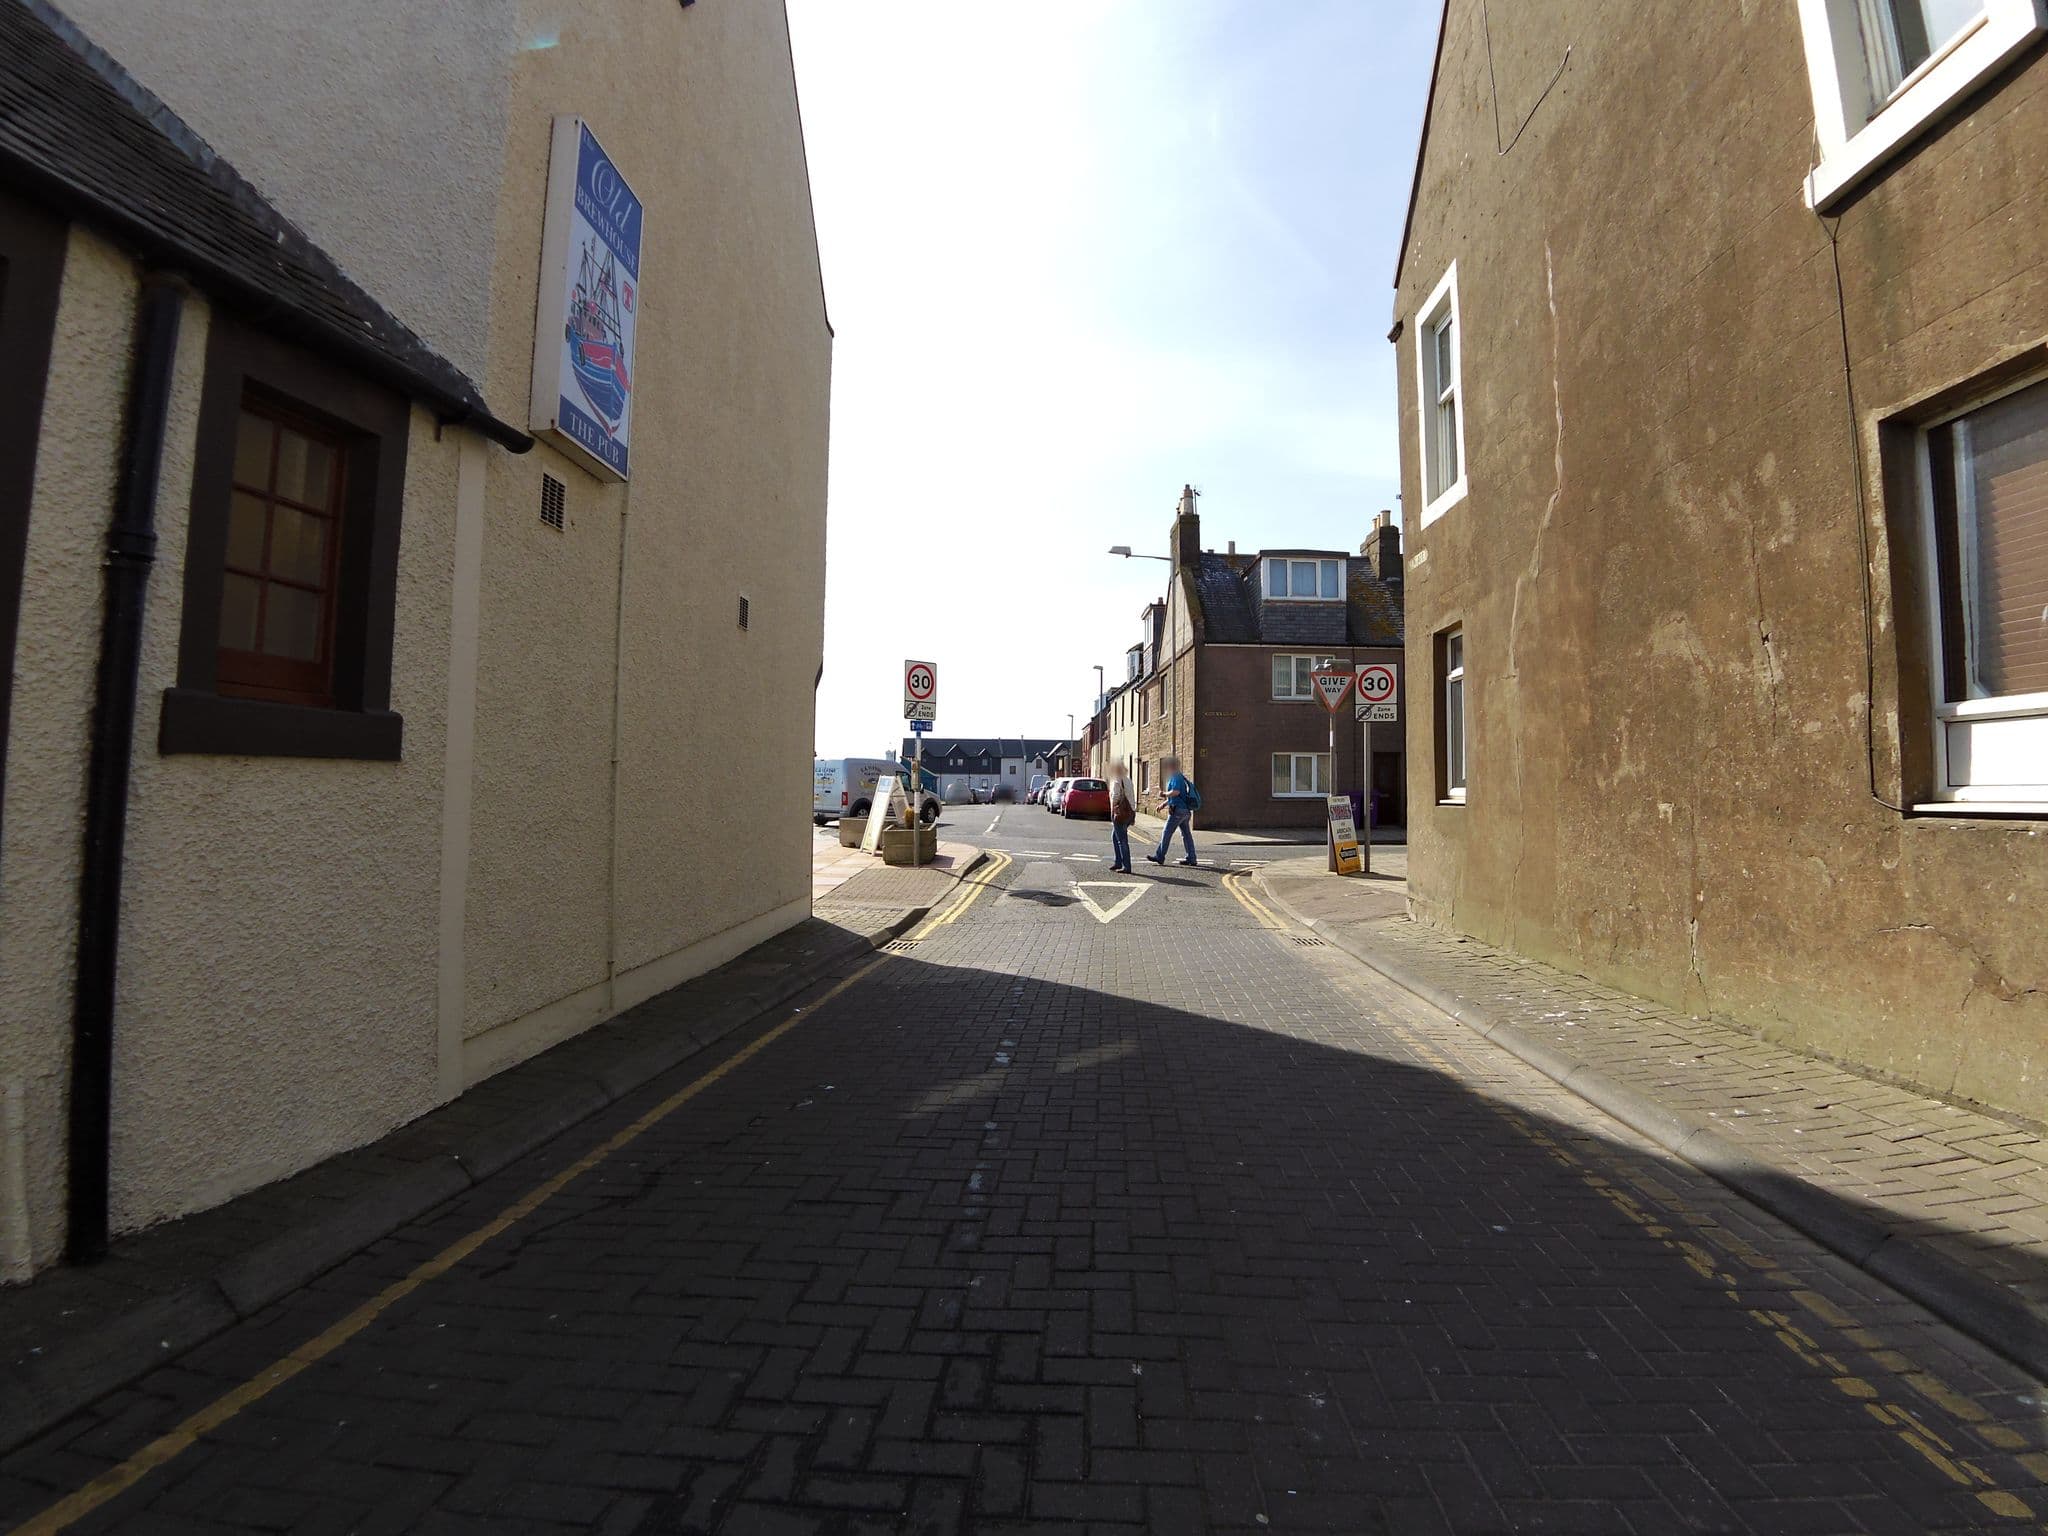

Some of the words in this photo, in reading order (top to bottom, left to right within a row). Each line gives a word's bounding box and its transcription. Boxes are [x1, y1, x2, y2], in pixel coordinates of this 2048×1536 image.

[591, 160, 632, 234] Old
[577, 184, 636, 272] BREWHOUSE
[570, 411, 594, 446] THE
[598, 434, 619, 464] PUB
[912, 674, 931, 690] 30
[1320, 677, 1346, 686] GIVE
[1363, 676, 1390, 692] 30
